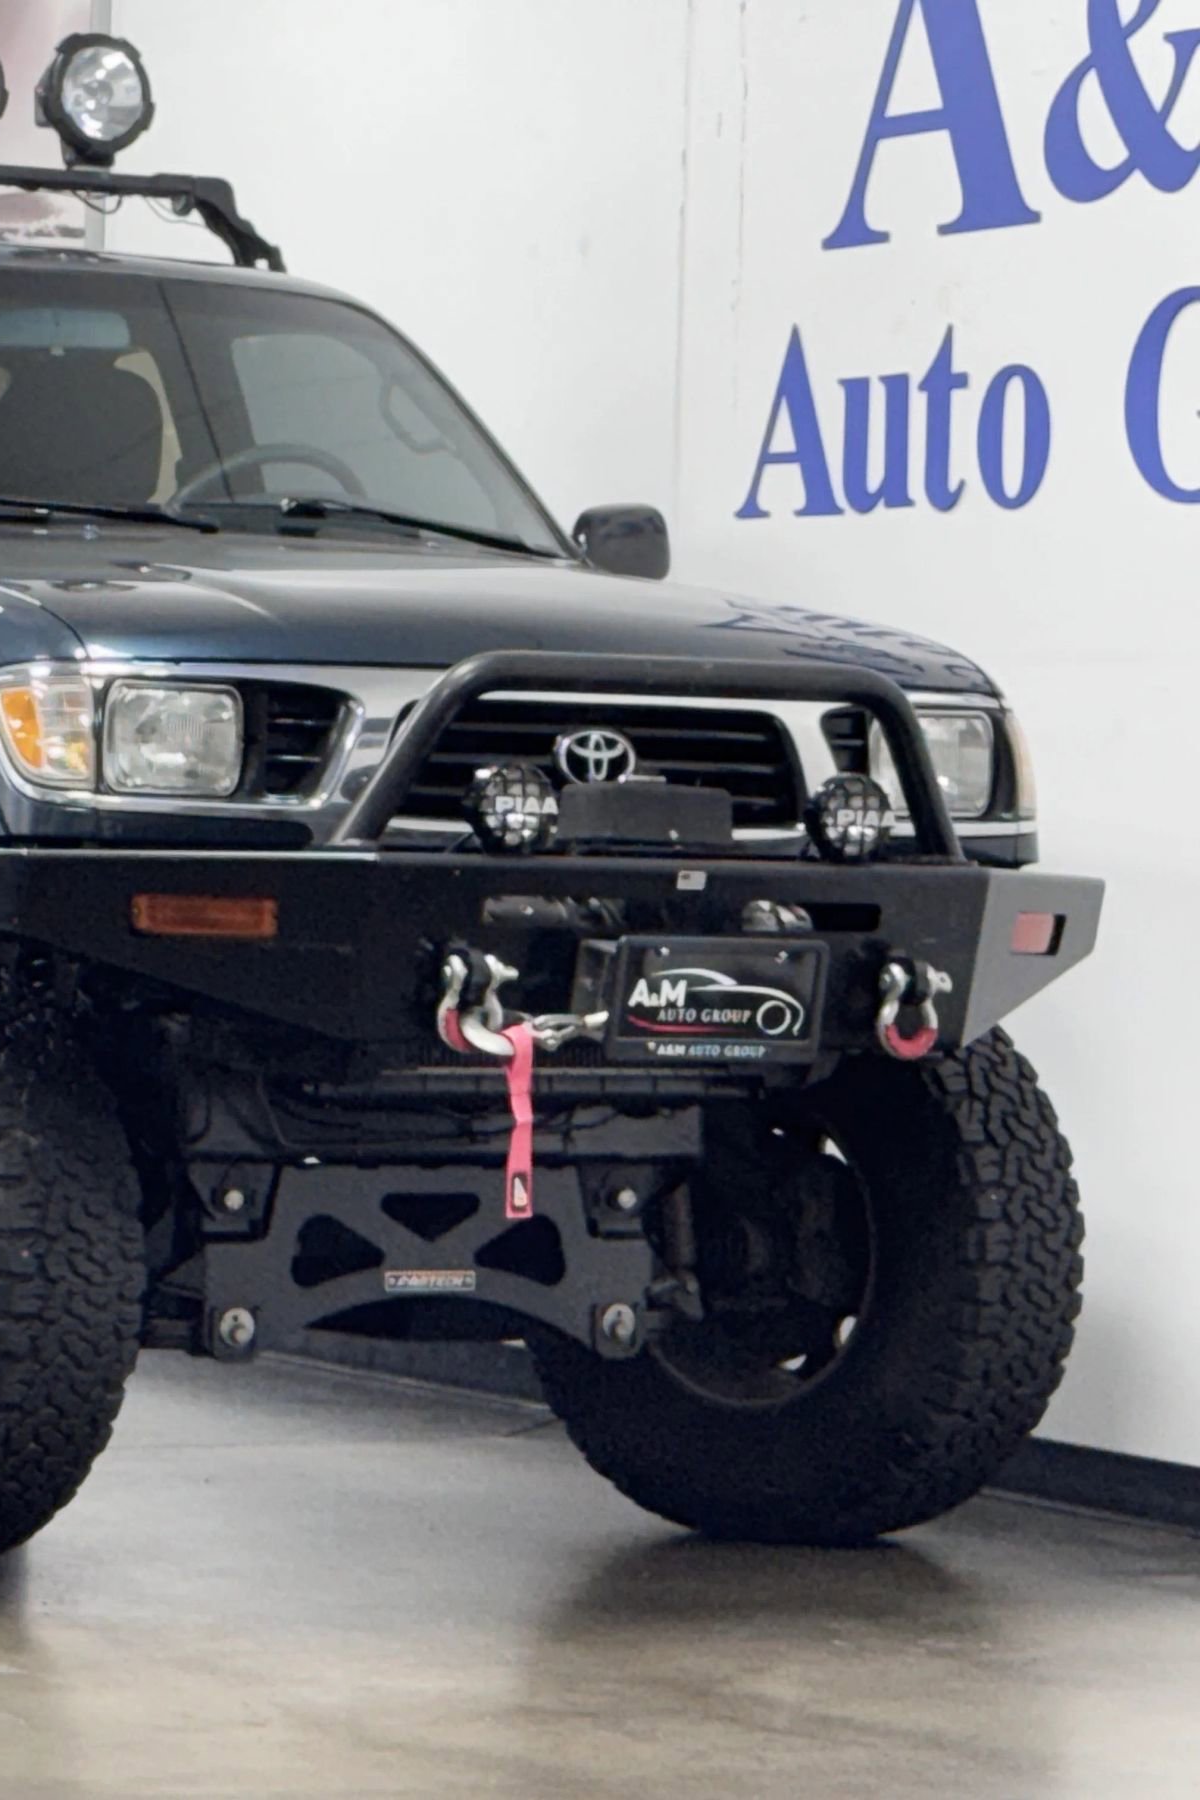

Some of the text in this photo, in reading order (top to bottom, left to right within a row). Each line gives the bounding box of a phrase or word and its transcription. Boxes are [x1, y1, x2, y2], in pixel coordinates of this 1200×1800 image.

[733, 323, 1051, 519] Auto
[495, 795, 558, 815] PIAA
[837, 809, 896, 828] PIAA
[627, 978, 687, 1008] A&M
[657, 1008, 751, 1024] AUTO GROUP
[688, 1045, 721, 1057] AUTO
[724, 1045, 766, 1058] GROUP
